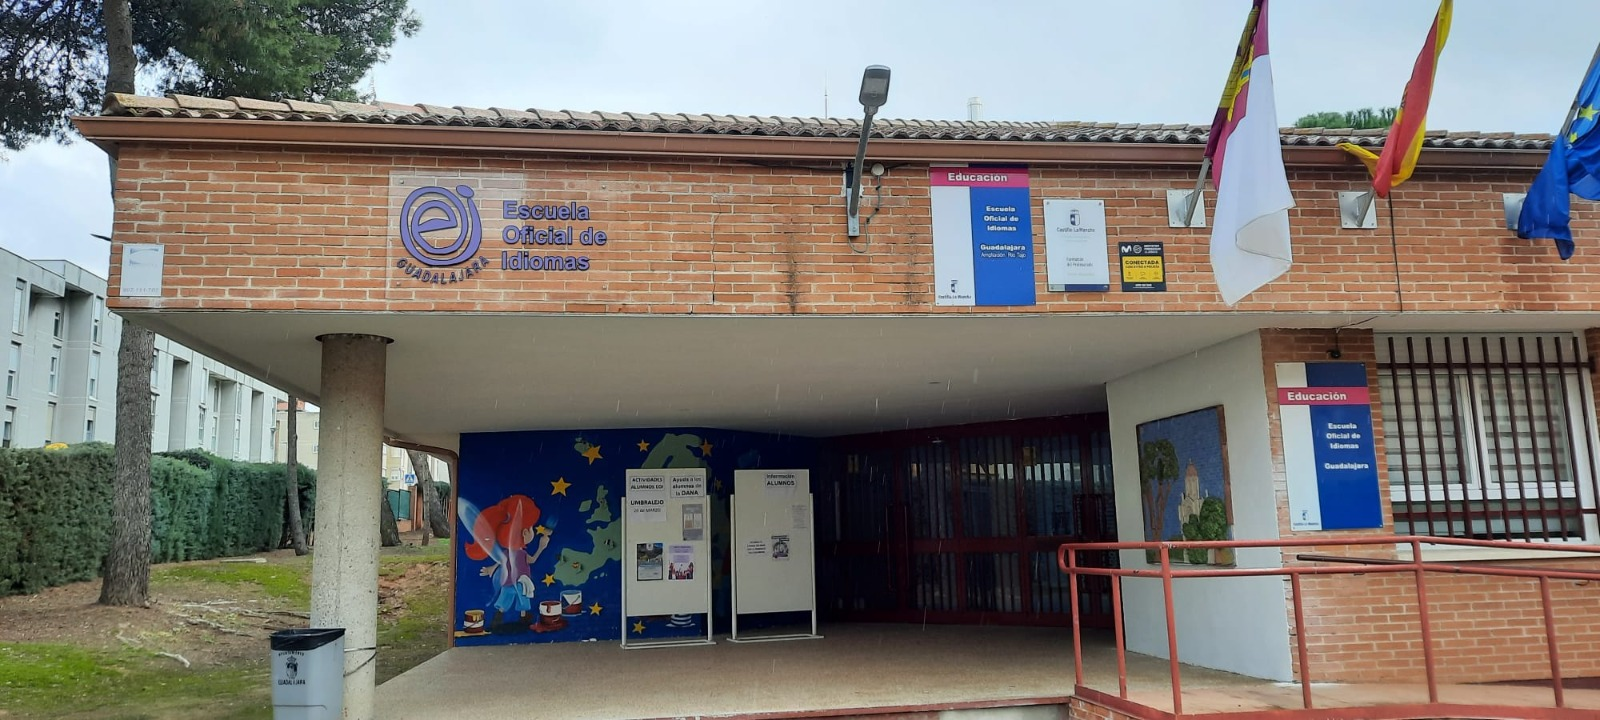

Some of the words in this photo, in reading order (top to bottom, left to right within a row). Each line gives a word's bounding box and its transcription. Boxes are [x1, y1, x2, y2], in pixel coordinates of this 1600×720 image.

[948, 172, 1008, 182] Educación
[502, 200, 590, 220] Escuela
[502, 225, 573, 245] Oficial
[579, 227, 607, 246] de
[980, 244, 1026, 252] Guadalajara
[501, 251, 590, 271] Idiomas
[396, 255, 490, 285] GUADALAJARA
[1287, 391, 1347, 401] Educación
[1324, 463, 1369, 471] Guadalajara
